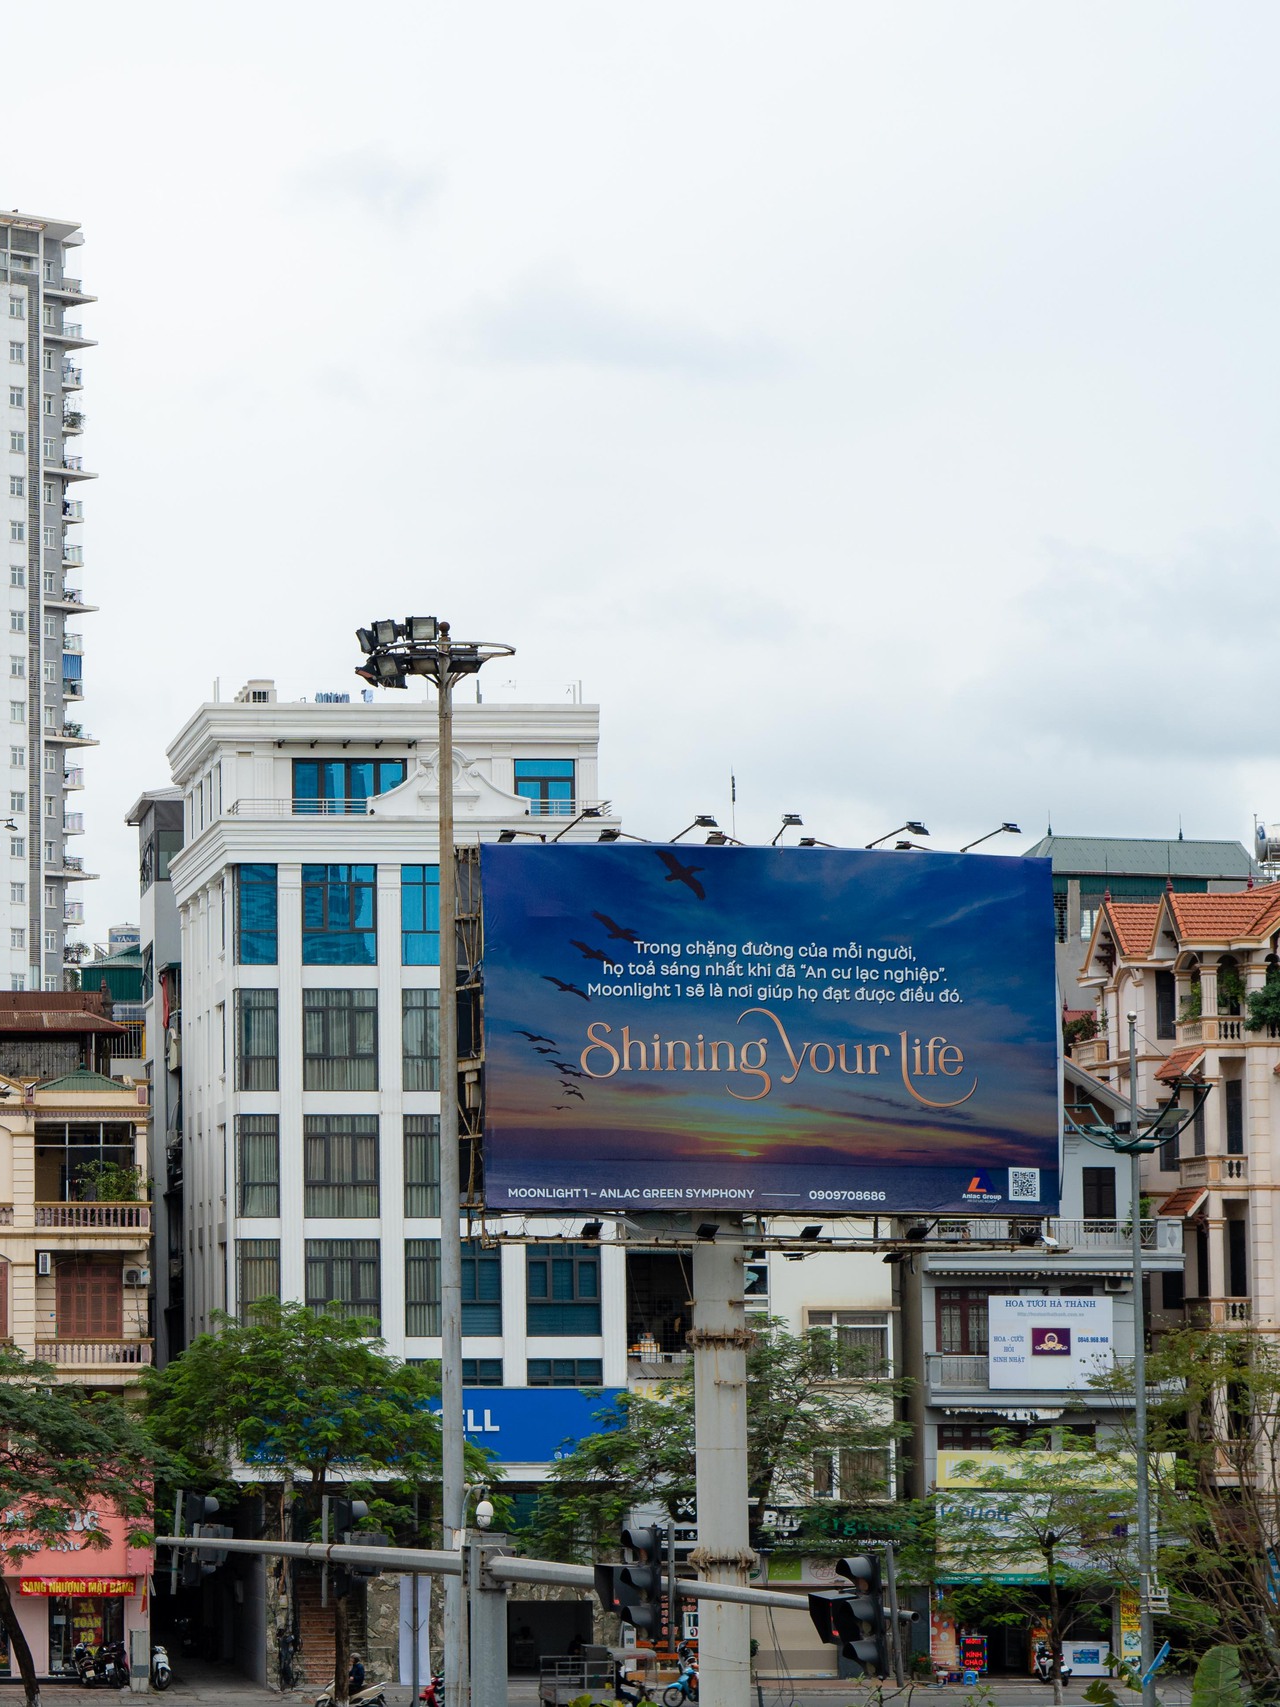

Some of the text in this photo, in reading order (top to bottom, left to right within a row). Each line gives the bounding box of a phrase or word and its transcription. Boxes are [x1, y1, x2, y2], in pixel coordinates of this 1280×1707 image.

[633, 941, 917, 962] Trong chặng đường của mỗi người,
[603, 961, 624, 978] họ
[628, 960, 656, 976] toả
[660, 961, 701, 978] sáng
[705, 960, 744, 976] nhất
[748, 962, 771, 977] khi
[775, 963, 796, 978] đã
[831, 967, 852, 979] cư
[856, 966, 880, 982] lạc
[587, 983, 964, 1004] Moonlight 1 sẽ là nơi giúp họ đạt được điều đó.
[580, 1021, 772, 1100] Shining
[899, 1030, 979, 1108] life
[508, 1188, 887, 1201] MOONLIGHT 1 ANLAC GREEN SYMPHONY 0909708686
[1005, 1299, 1096, 1308] HOA TƯƠI HÀ THÀNH
[22, 1581, 47, 1593] SANG
[49, 1581, 86, 1595] NHƯỢNG
